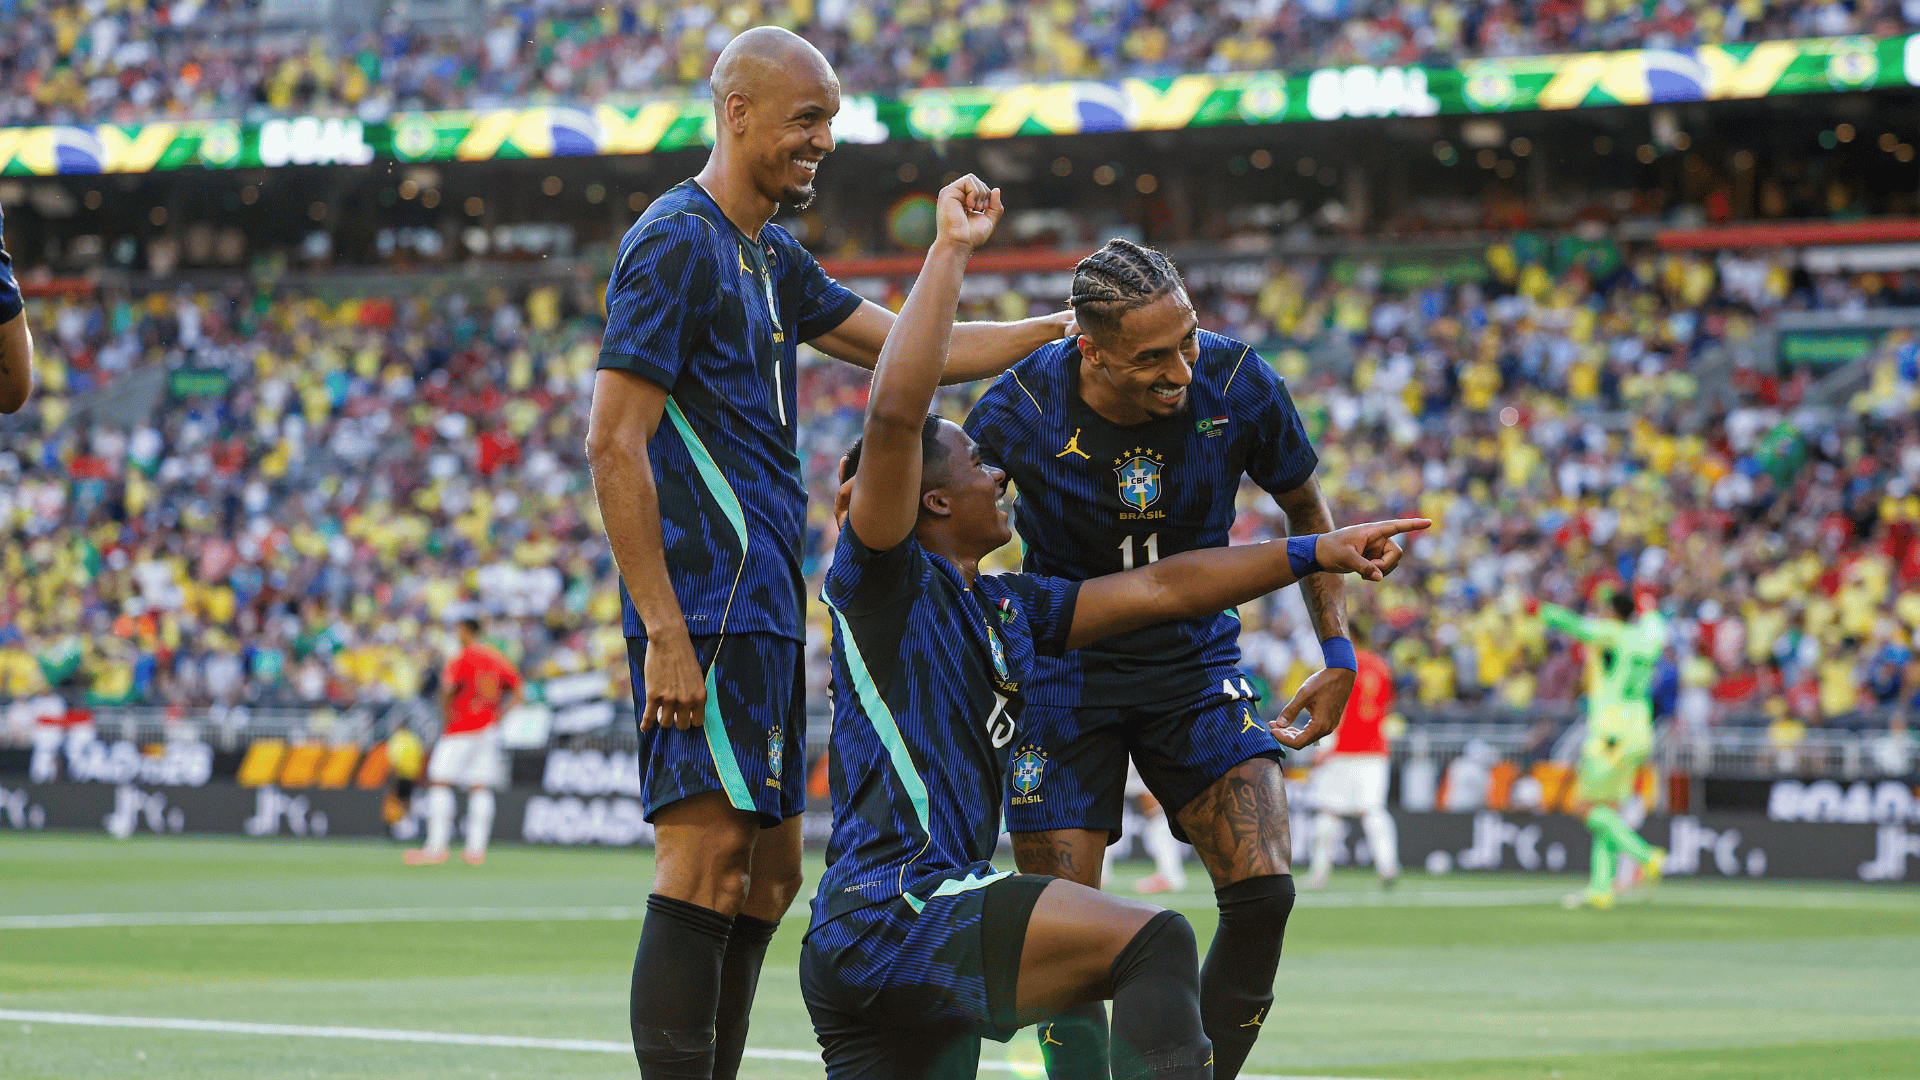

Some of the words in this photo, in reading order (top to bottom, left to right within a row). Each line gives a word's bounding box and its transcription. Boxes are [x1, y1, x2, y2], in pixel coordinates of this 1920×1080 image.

[1130, 476, 1148, 485] CBF
[1119, 509, 1166, 520] BRASIL
[1117, 532, 1159, 571] 11
[1011, 794, 1044, 805] BRASIL
